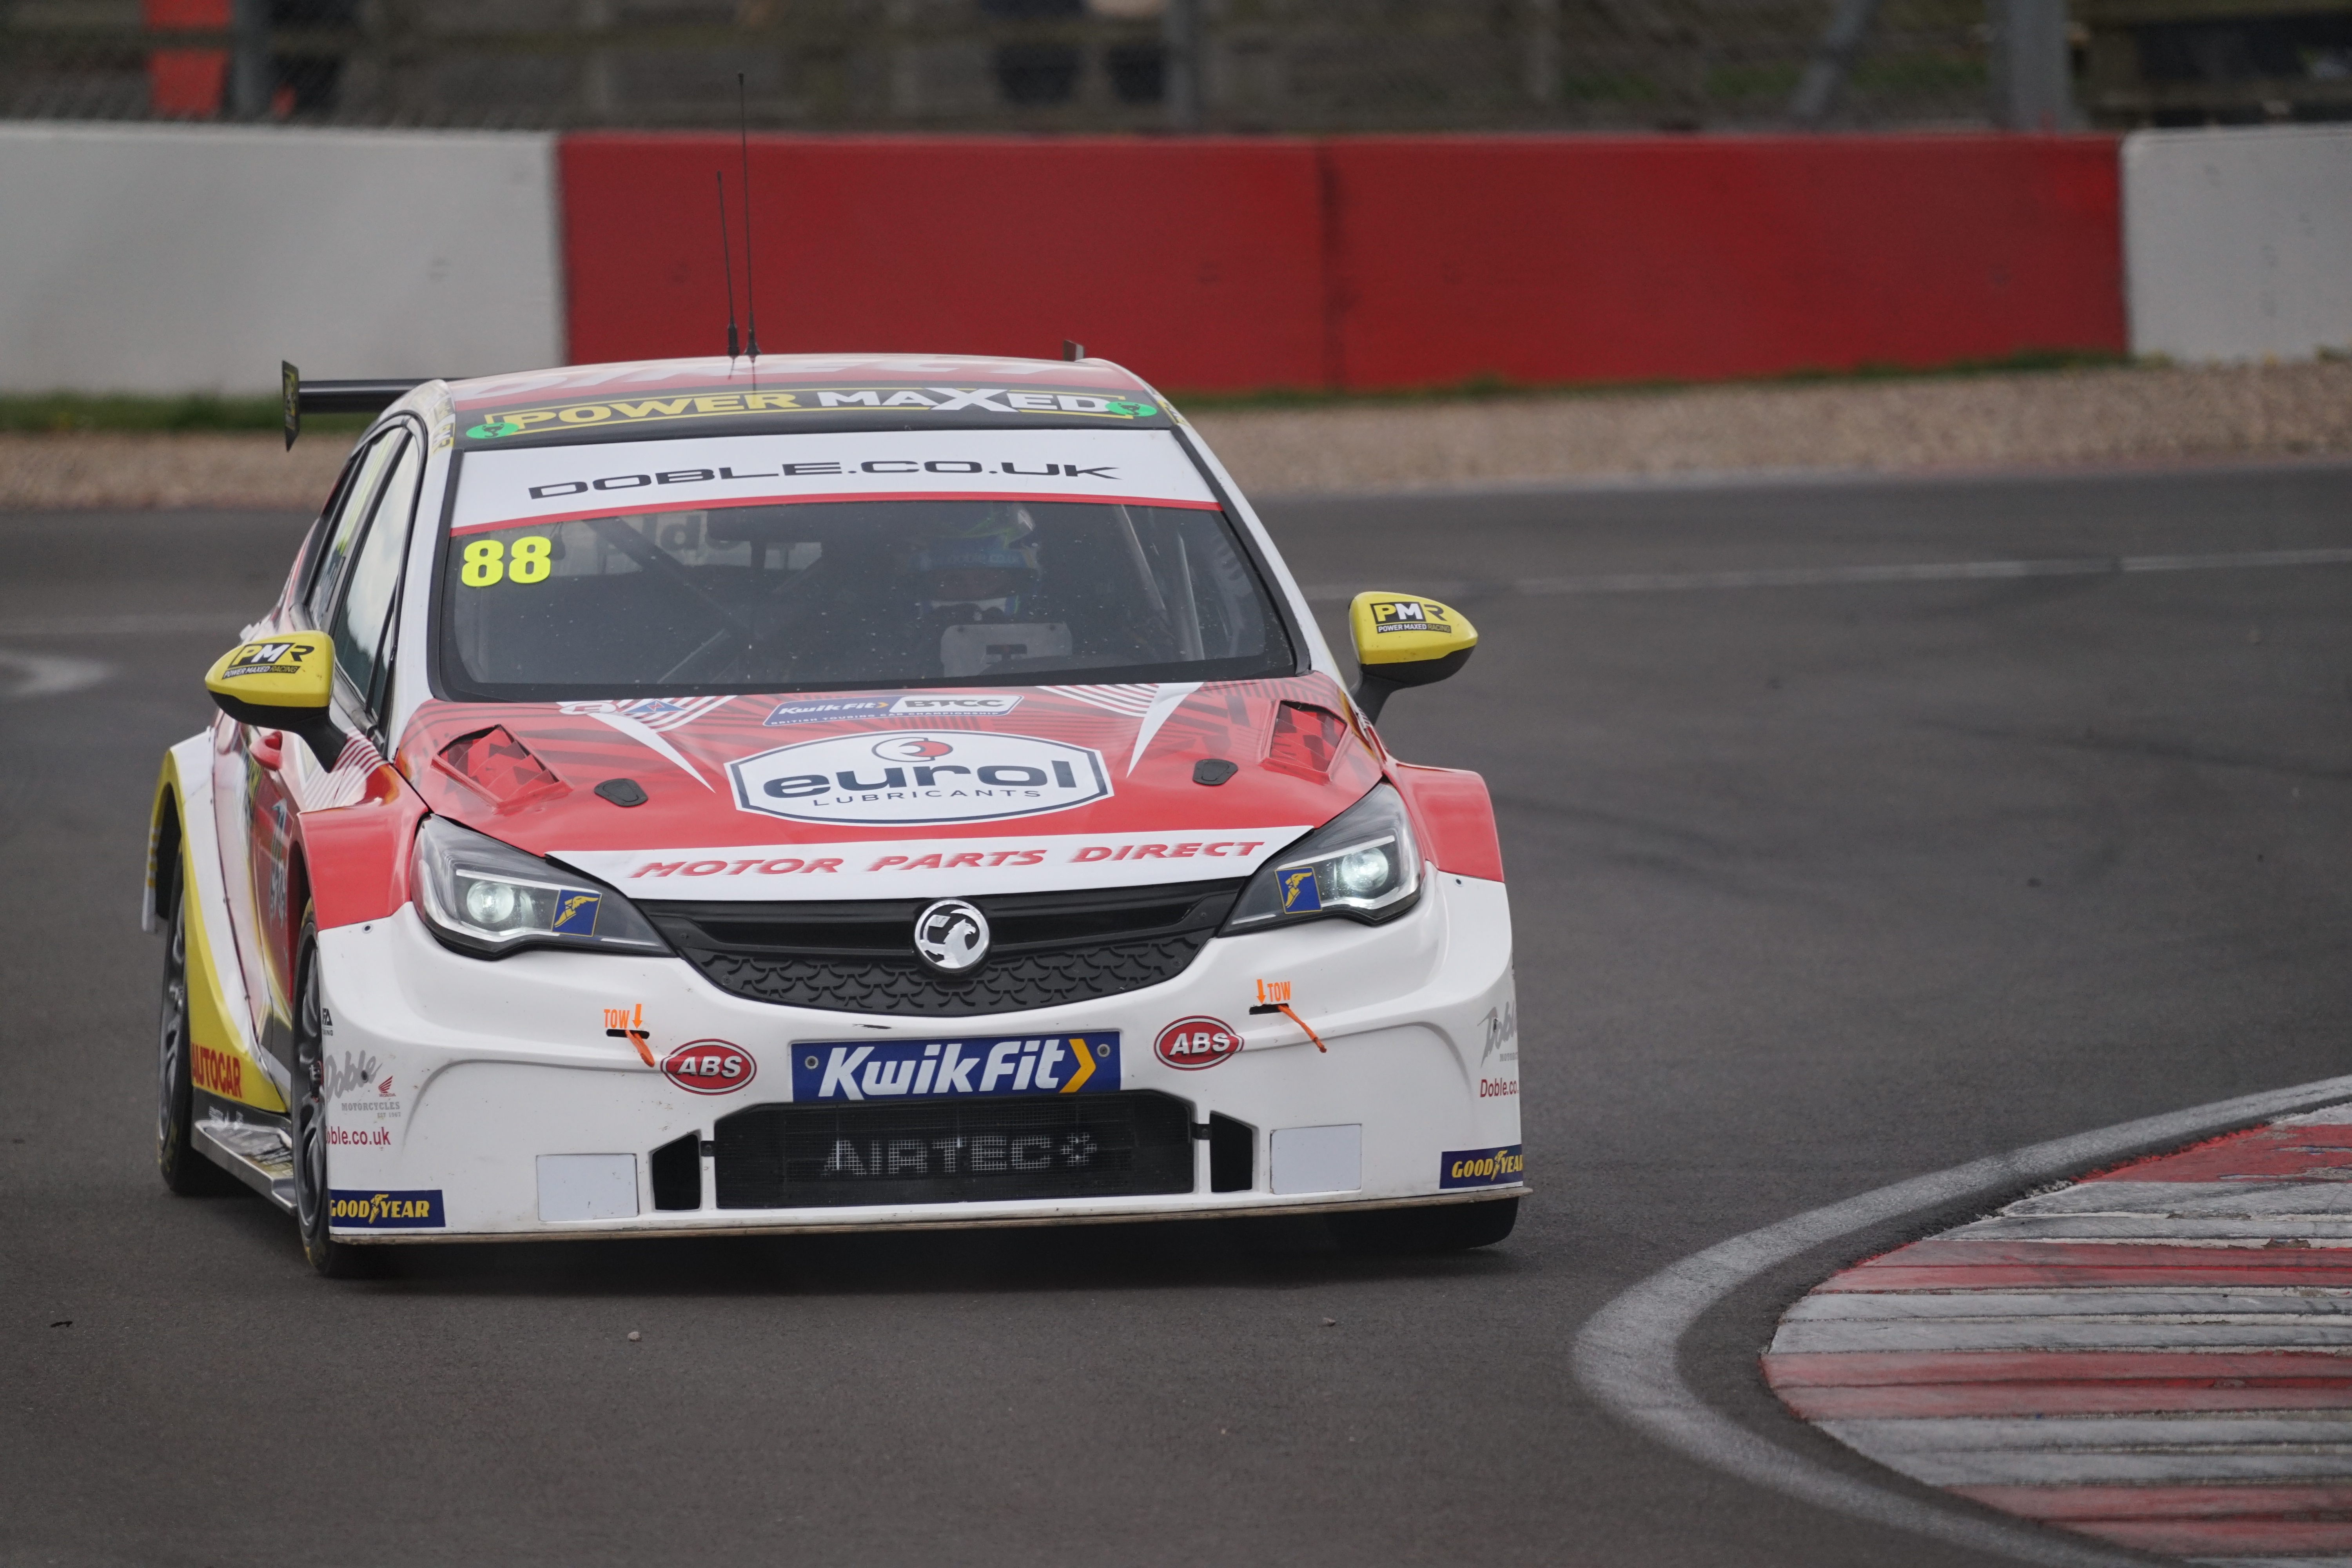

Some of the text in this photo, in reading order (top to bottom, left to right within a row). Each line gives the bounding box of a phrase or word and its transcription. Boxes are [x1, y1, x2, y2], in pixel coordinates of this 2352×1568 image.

[502, 388, 1110, 429] POWER MAXED
[528, 461, 1123, 499] DOBLE.CO.UK
[461, 536, 551, 587] 88
[1373, 603, 1447, 621] PMR
[234, 644, 315, 665] PMR
[223, 668, 247, 678] POWER
[763, 760, 1076, 799] eurol
[813, 789, 1041, 806] LUBRICANTS
[628, 841, 1265, 878] MOTOR PARTS DIRECT
[1267, 981, 1290, 1002] TOW
[604, 1009, 630, 1029] TOW
[1169, 1033, 1230, 1056] ABS
[192, 1043, 242, 1099] AUTOCAR
[677, 1056, 742, 1078] ABS
[341, 1102, 400, 1111] MOTORCYCLES
[326, 1126, 391, 1145] oble.co.uk
[821, 1135, 1052, 1176] AIRTEC
